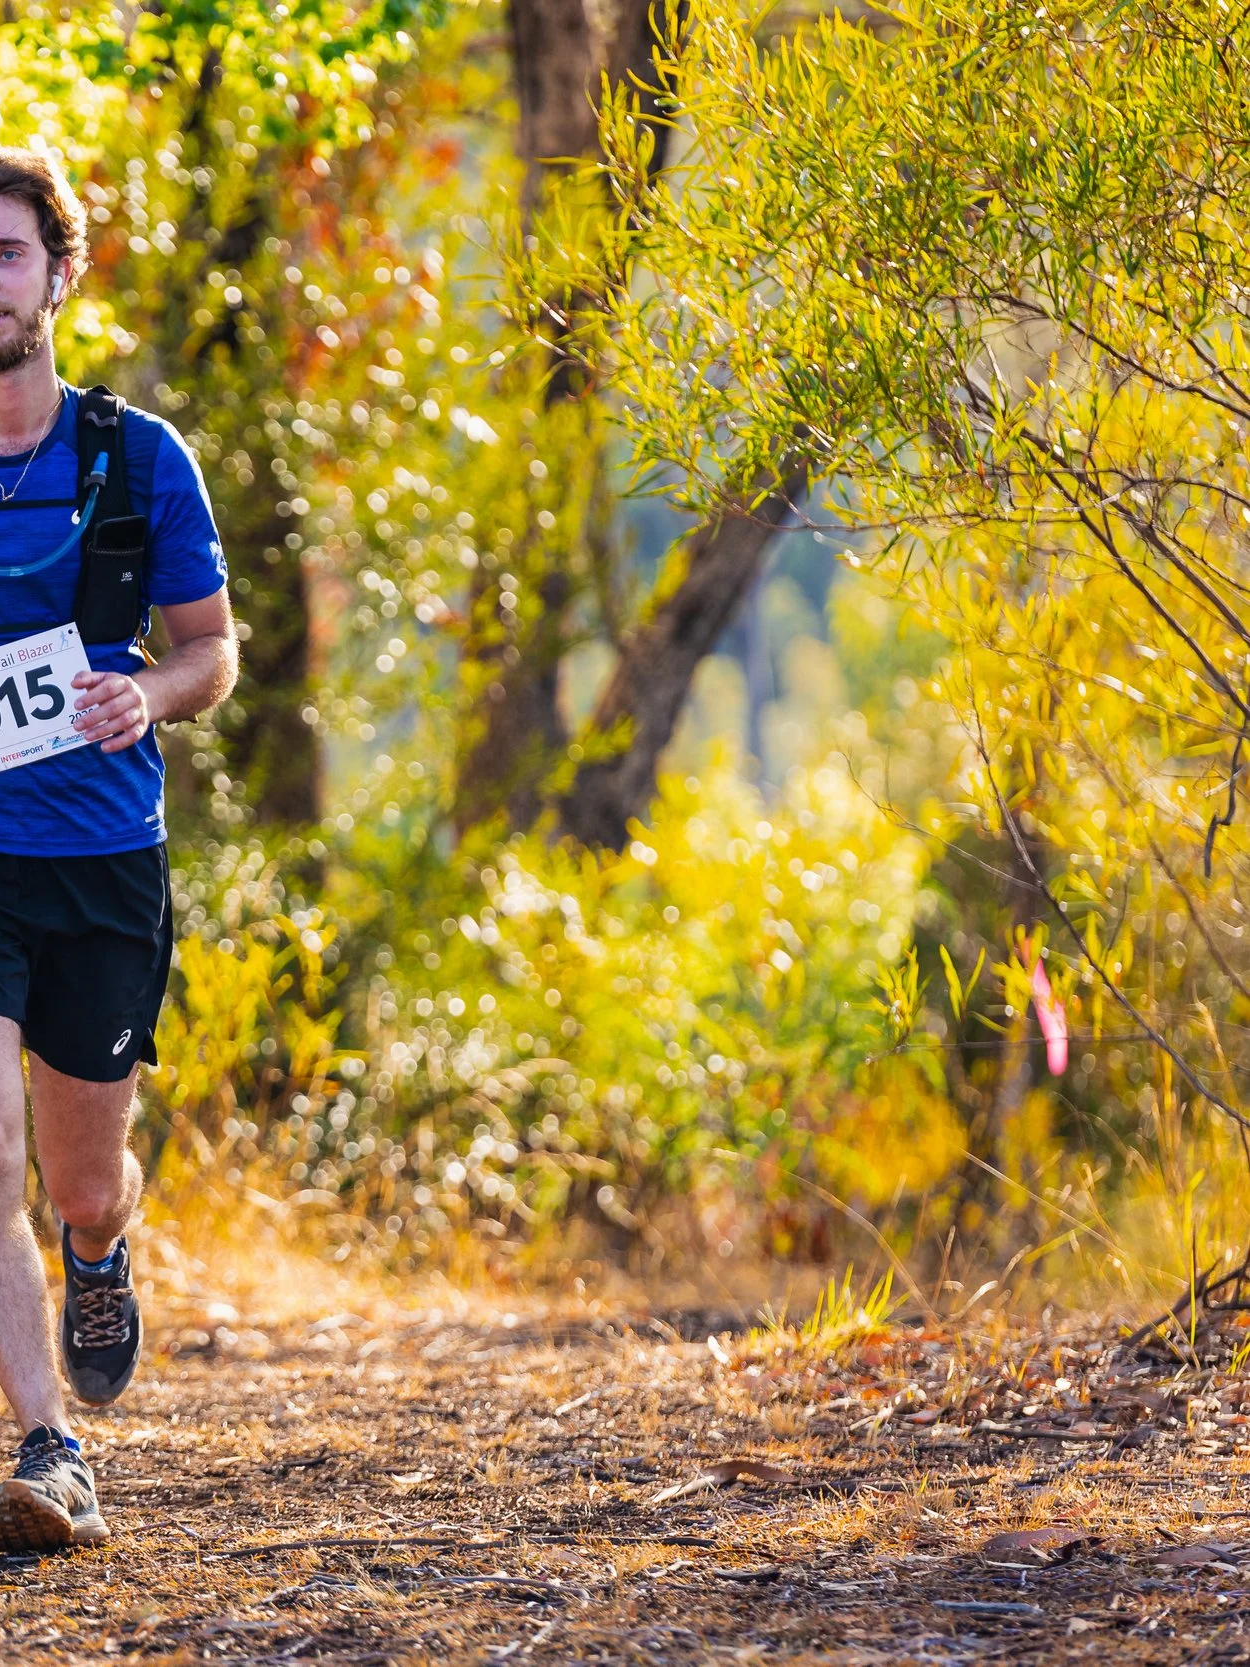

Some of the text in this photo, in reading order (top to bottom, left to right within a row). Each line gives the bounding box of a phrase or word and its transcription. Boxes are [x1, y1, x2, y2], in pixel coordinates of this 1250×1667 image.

[17, 643, 54, 662] Blazer
[68, 708, 94, 725] 20
[0, 744, 45, 764] INTERSPORT
